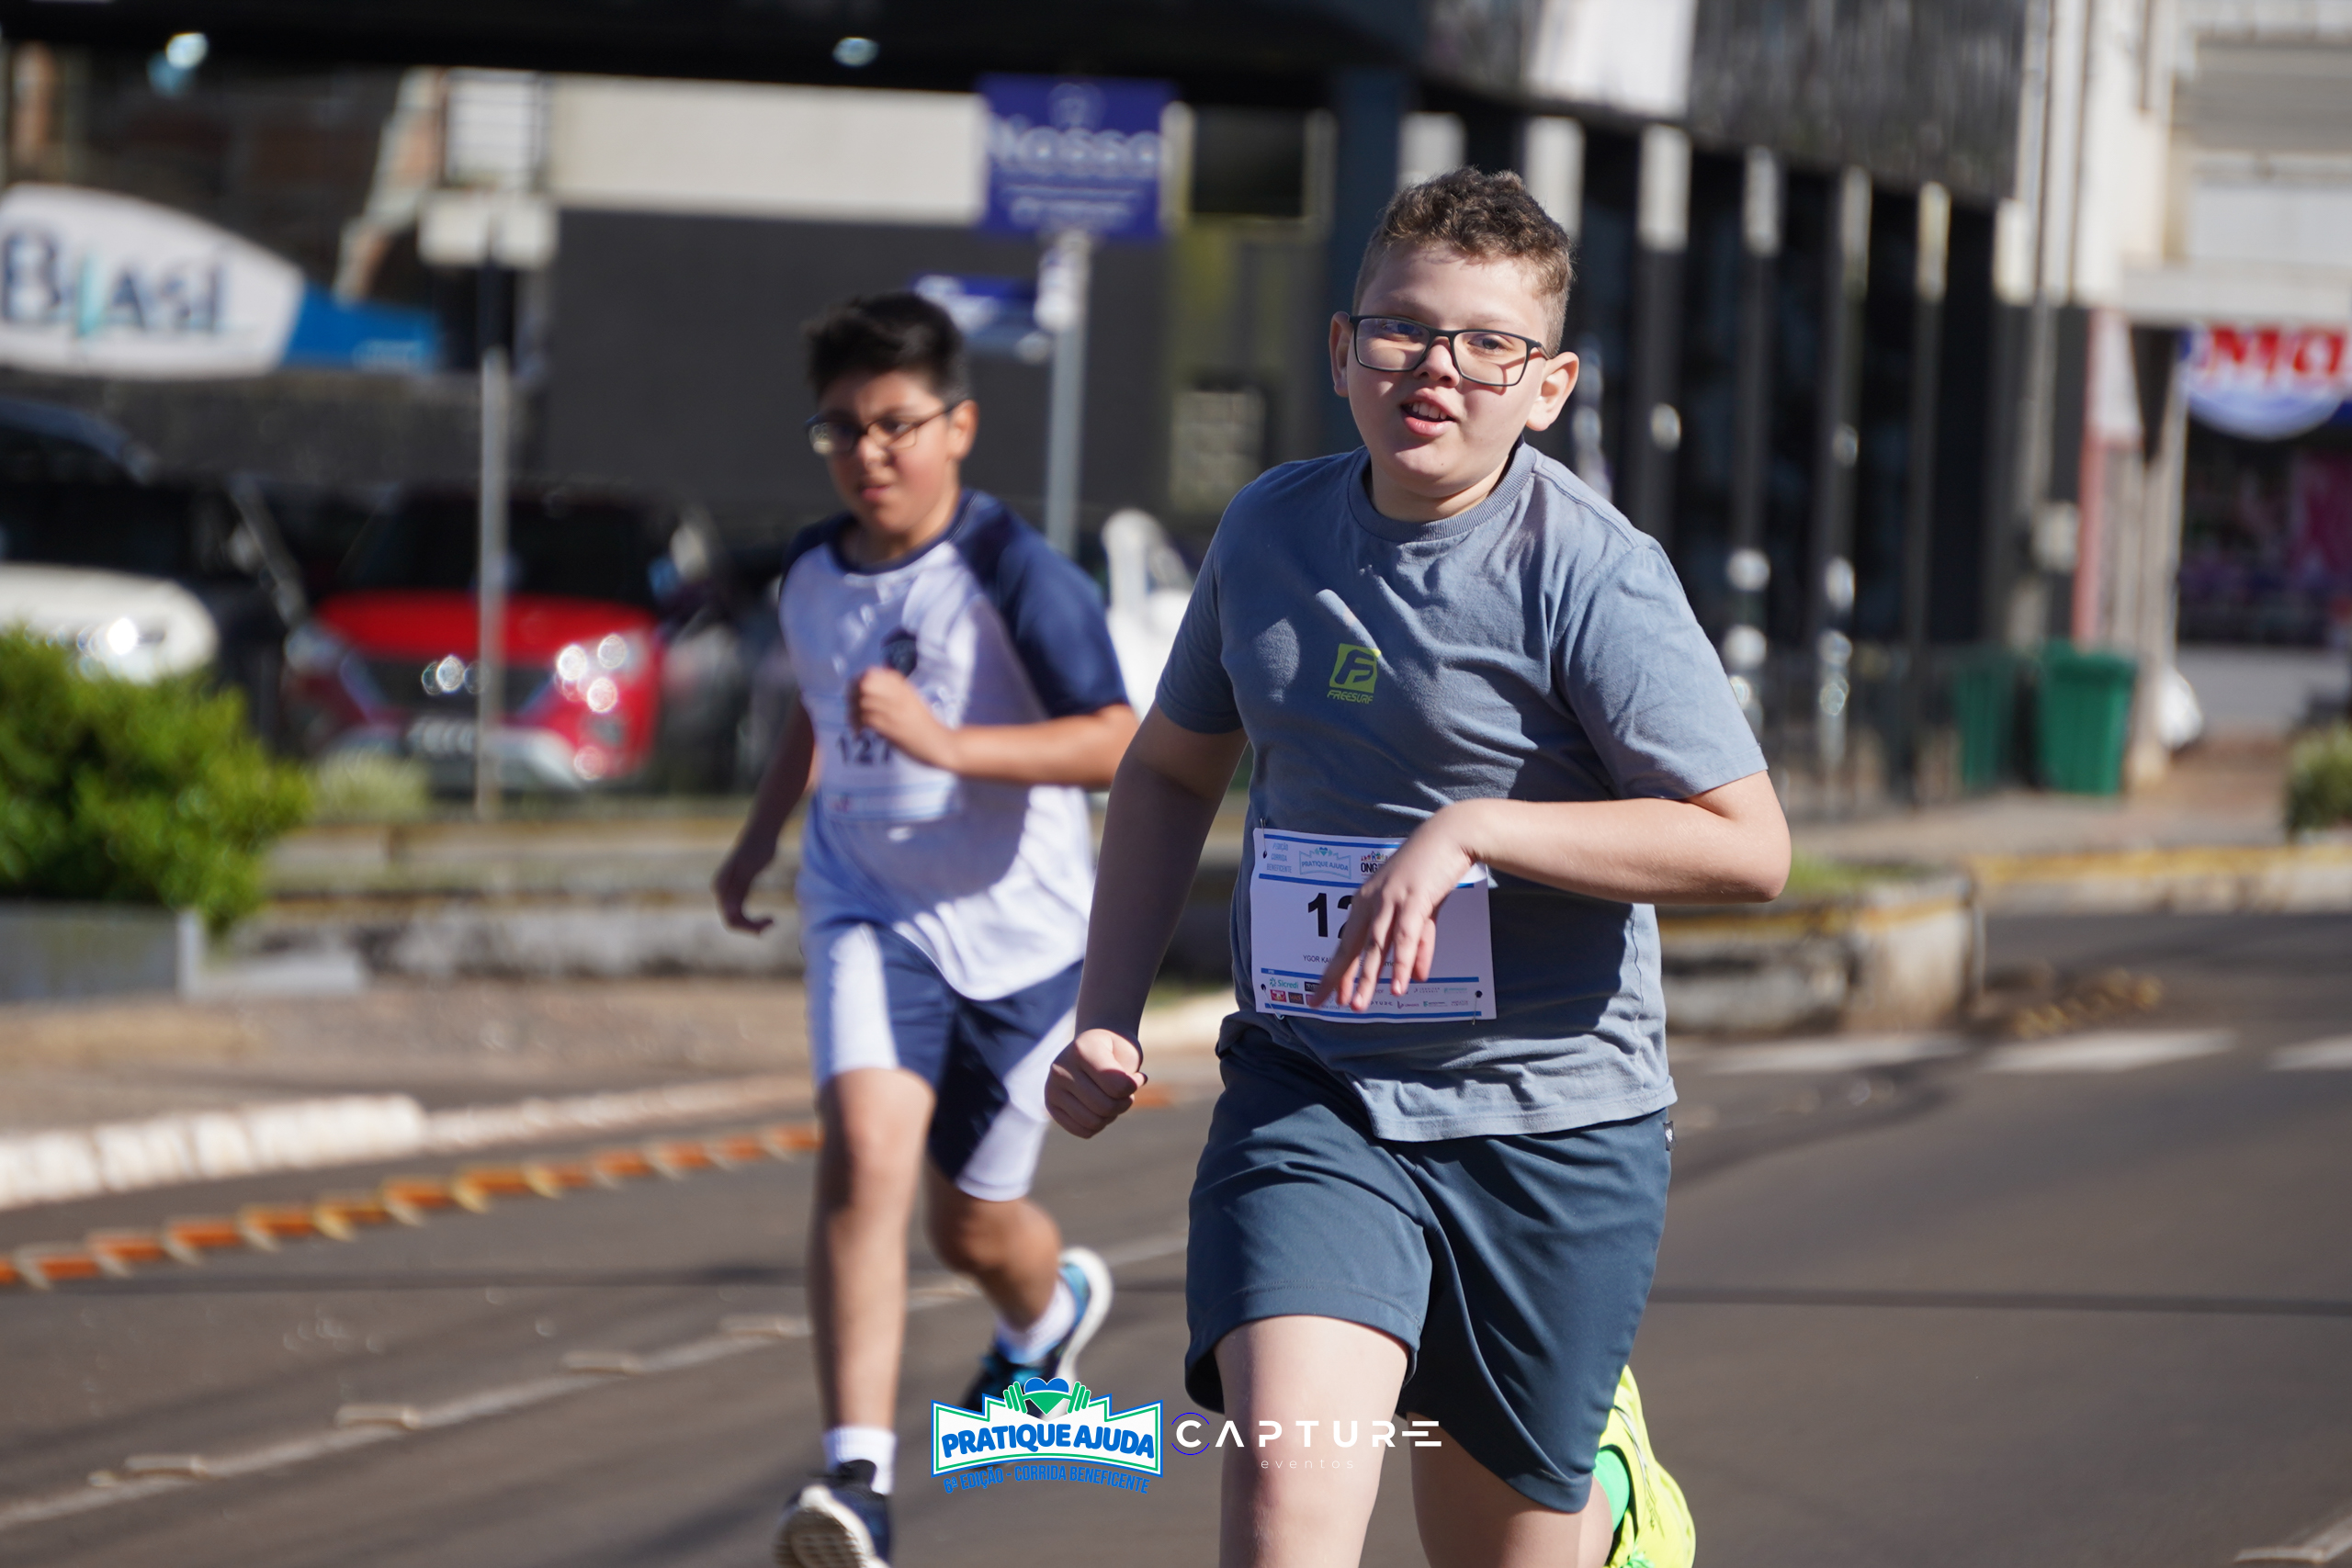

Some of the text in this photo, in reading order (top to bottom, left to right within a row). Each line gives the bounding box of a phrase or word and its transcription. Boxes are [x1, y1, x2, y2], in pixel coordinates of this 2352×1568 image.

[1327, 689, 1374, 705] FREESURF
[1301, 860, 1349, 872] PRATIQUE AJUDA
[1277, 979, 1299, 989] Sicredi
